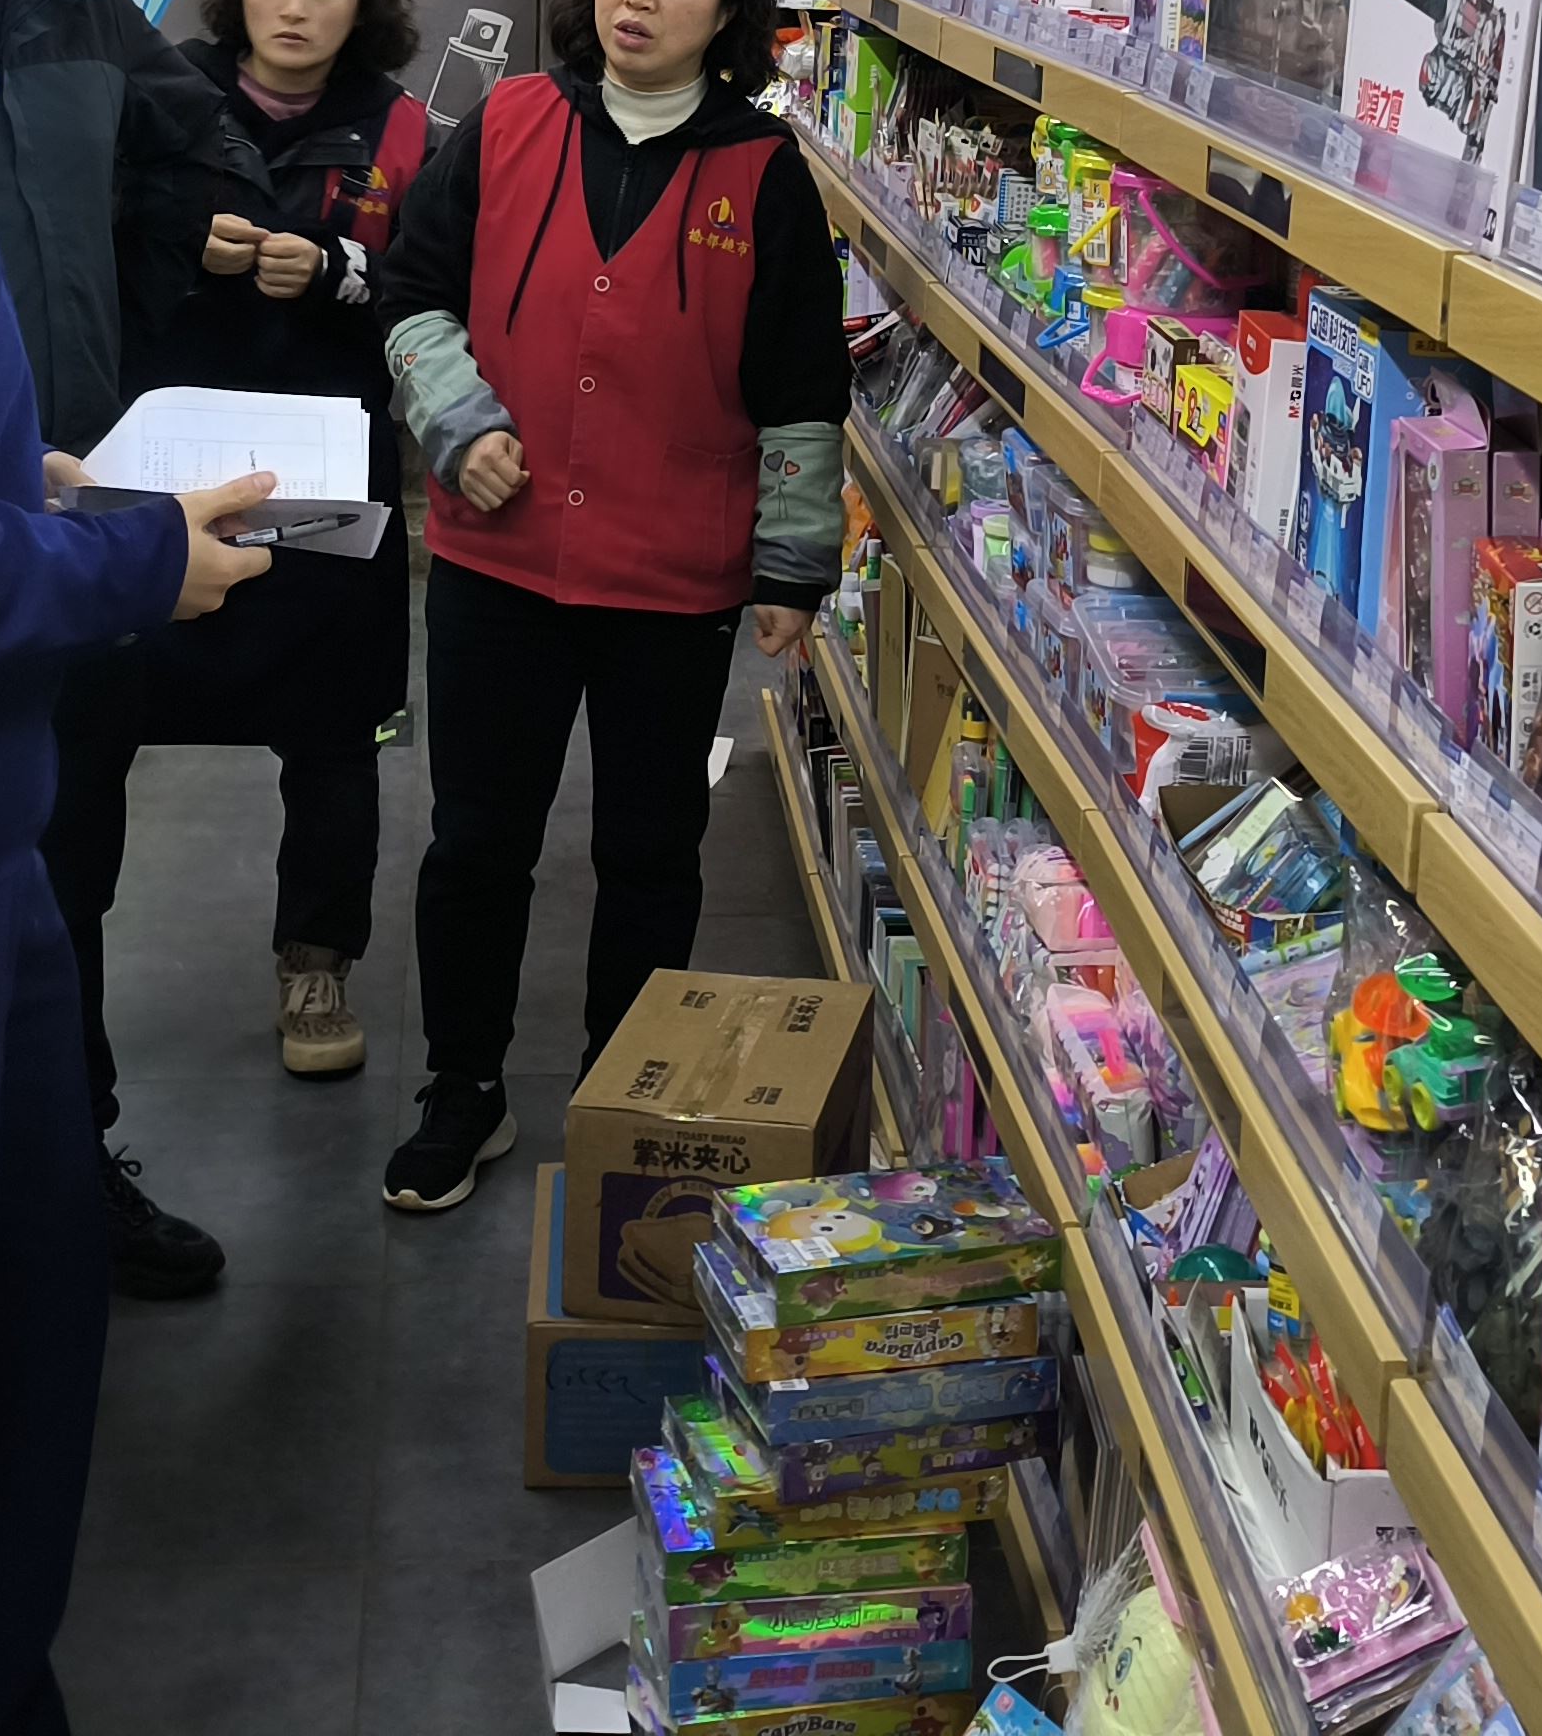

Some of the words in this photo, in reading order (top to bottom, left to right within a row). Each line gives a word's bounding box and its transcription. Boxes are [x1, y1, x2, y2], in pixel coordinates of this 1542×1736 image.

[675, 1130, 709, 1143] TOAST
[710, 1134, 747, 1146] BREAD
[632, 1137, 752, 1176] 紫米夹心
[864, 1331, 964, 1363] CapyBara
